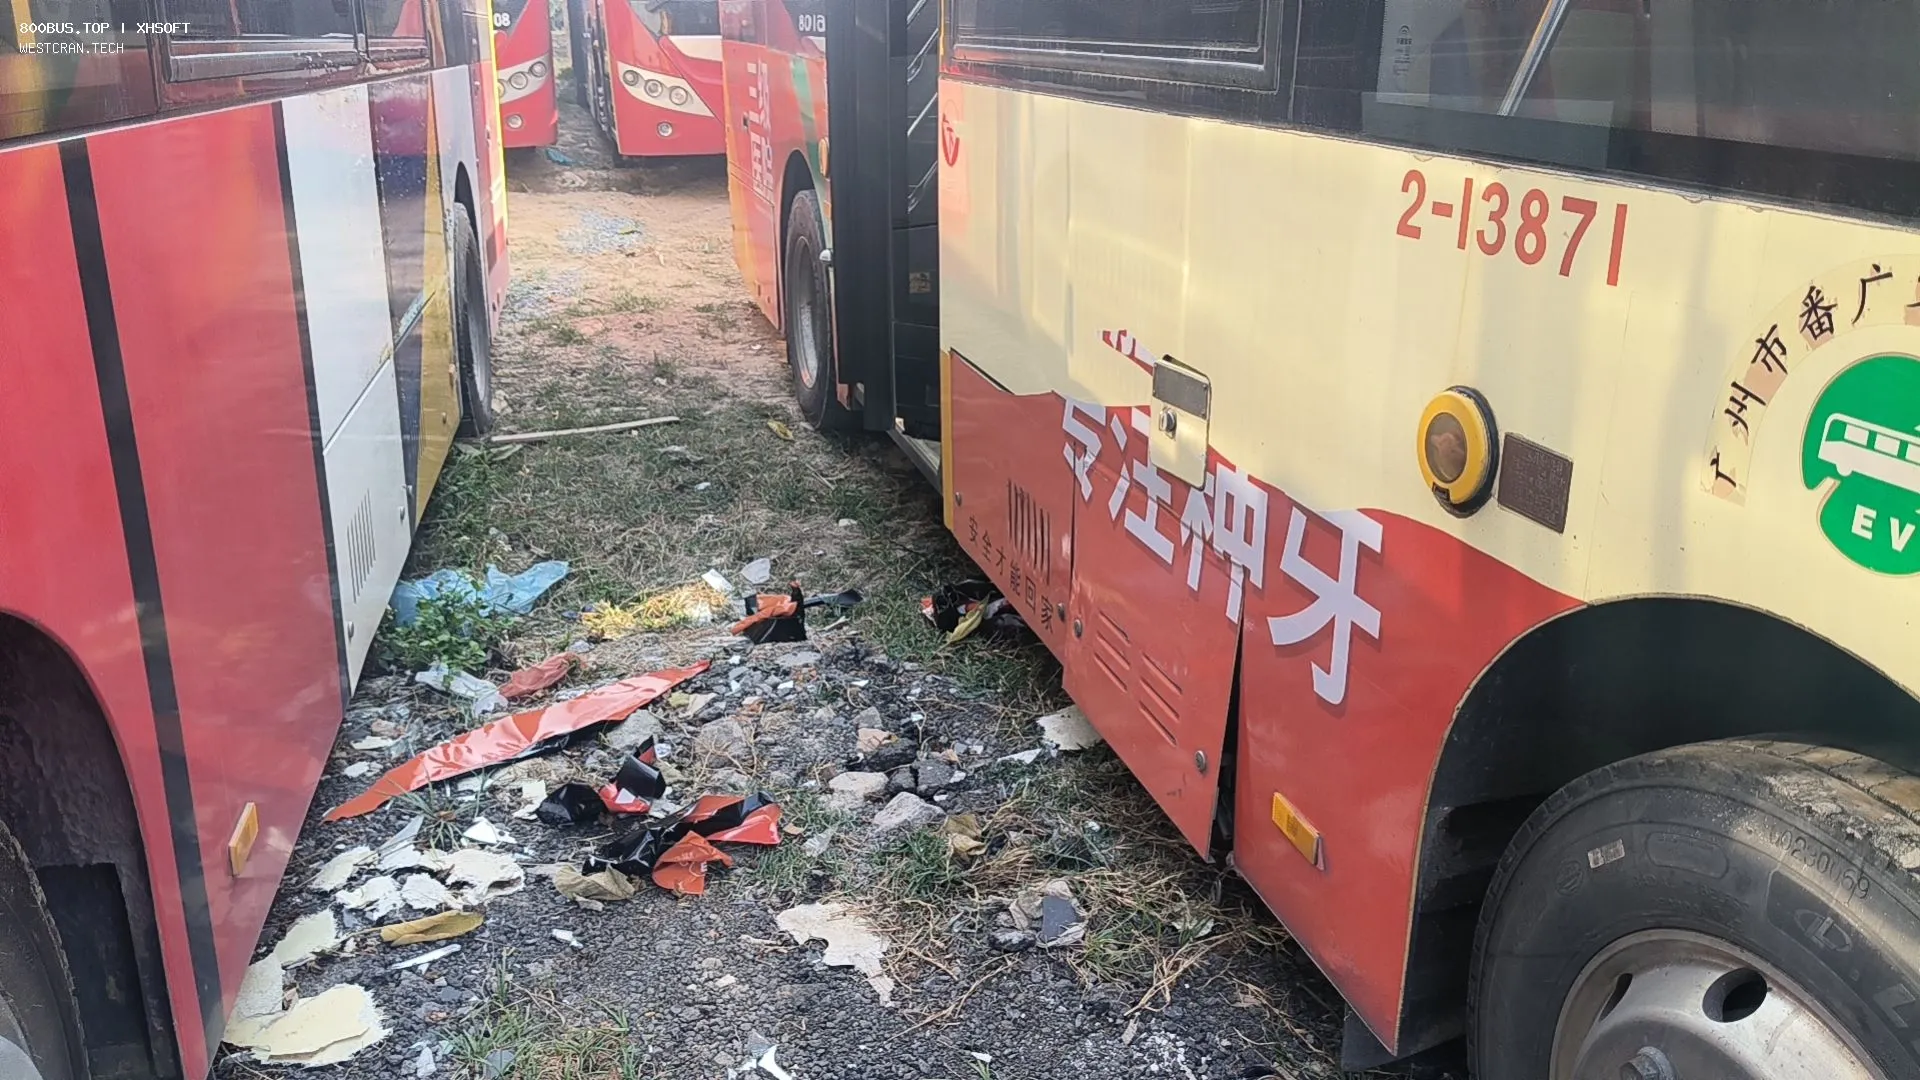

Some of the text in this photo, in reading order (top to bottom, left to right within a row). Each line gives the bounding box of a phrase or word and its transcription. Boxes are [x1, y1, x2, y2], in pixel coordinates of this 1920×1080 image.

[1396, 169, 1628, 287] 2-13871
[1709, 263, 1920, 488] 广州市番广
